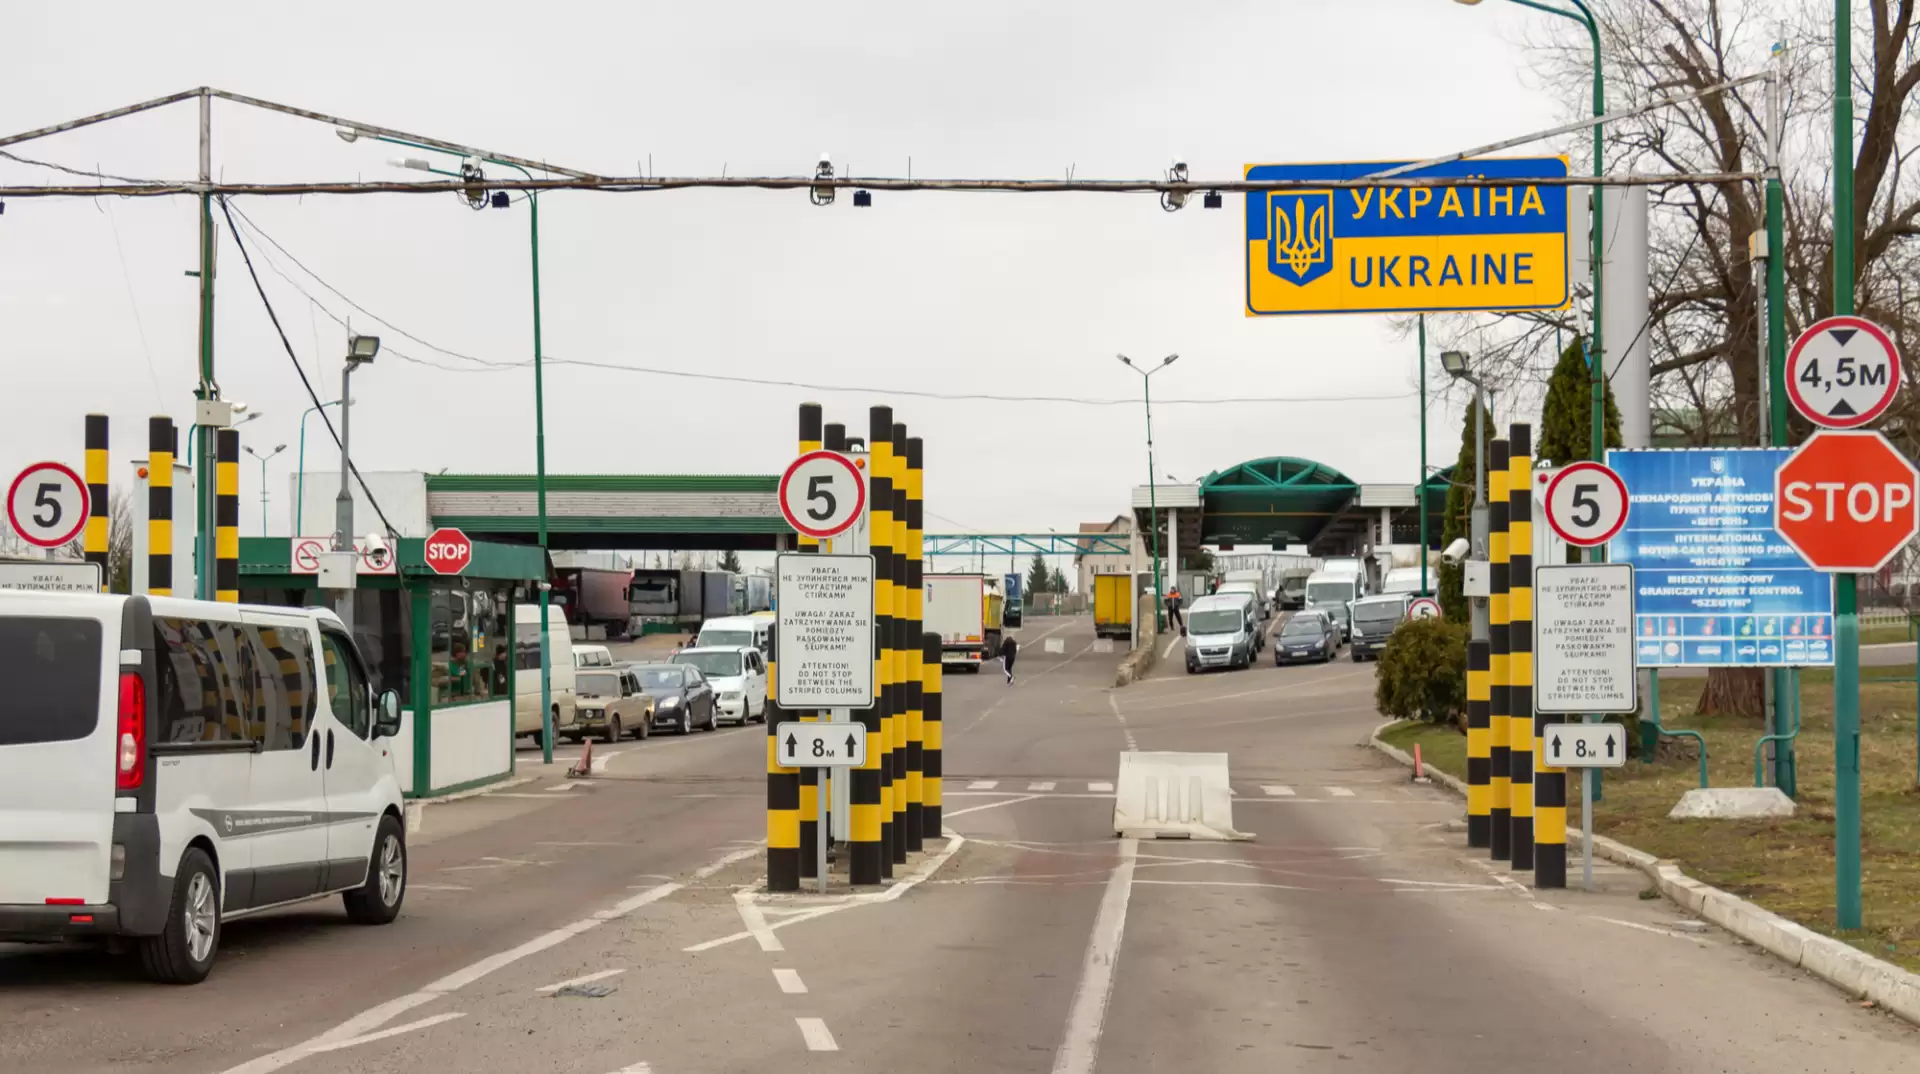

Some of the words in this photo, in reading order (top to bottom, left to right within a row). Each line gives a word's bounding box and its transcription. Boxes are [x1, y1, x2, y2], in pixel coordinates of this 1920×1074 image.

[1351, 175, 1545, 220] УКРАЇНА
[1351, 253, 1534, 288] UKRAINE
[1691, 476, 1745, 487] УКРАЇНА
[807, 475, 836, 521] 5
[1715, 493, 1773, 502] АВТОМОБІ
[1782, 481, 1911, 523] STOP
[33, 483, 62, 528] 5
[1571, 484, 1600, 528] 5
[1670, 505, 1707, 514] ПУНКТ
[1710, 505, 1769, 514] ПРОПУСКУ
[1675, 534, 1765, 543] INTERNATIONAL
[429, 543, 467, 560] STOP
[1639, 545, 1704, 554] MOTOR-CAR
[1707, 545, 1764, 554] CROSSING
[1639, 587, 1705, 596] GRANICZNY
[1708, 587, 1747, 595] PUNKT
[1420, 607, 1430, 619] 5
